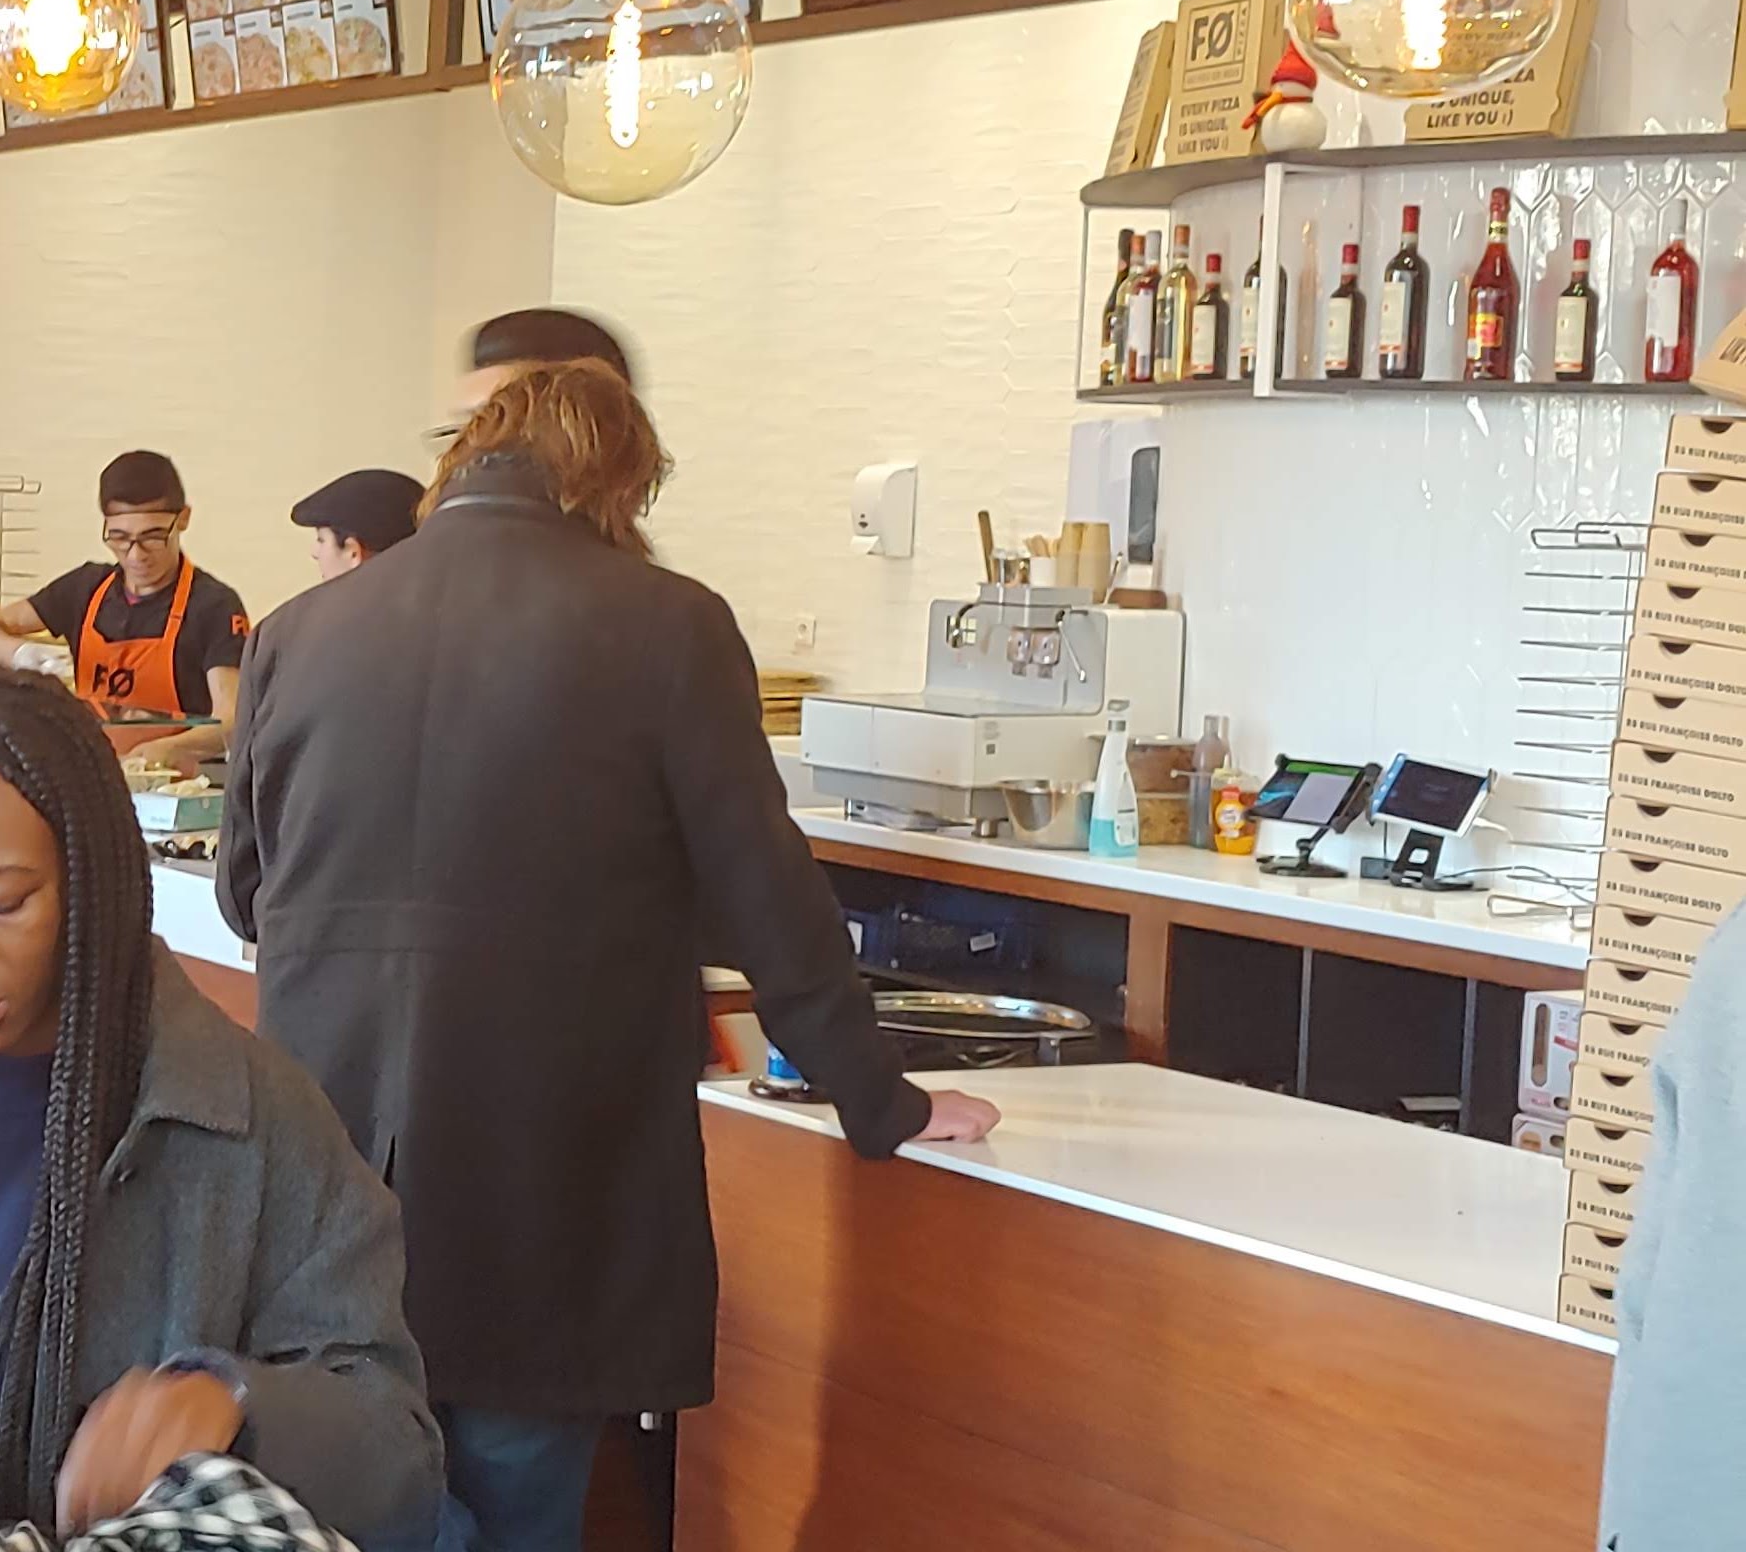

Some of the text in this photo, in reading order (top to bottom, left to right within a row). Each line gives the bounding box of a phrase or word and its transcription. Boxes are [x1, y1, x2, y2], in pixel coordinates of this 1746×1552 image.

[1191, 10, 1234, 61] FØ
[1428, 113, 1460, 128] LIKE
[1465, 110, 1498, 125] YOU
[92, 663, 135, 699] FØ
